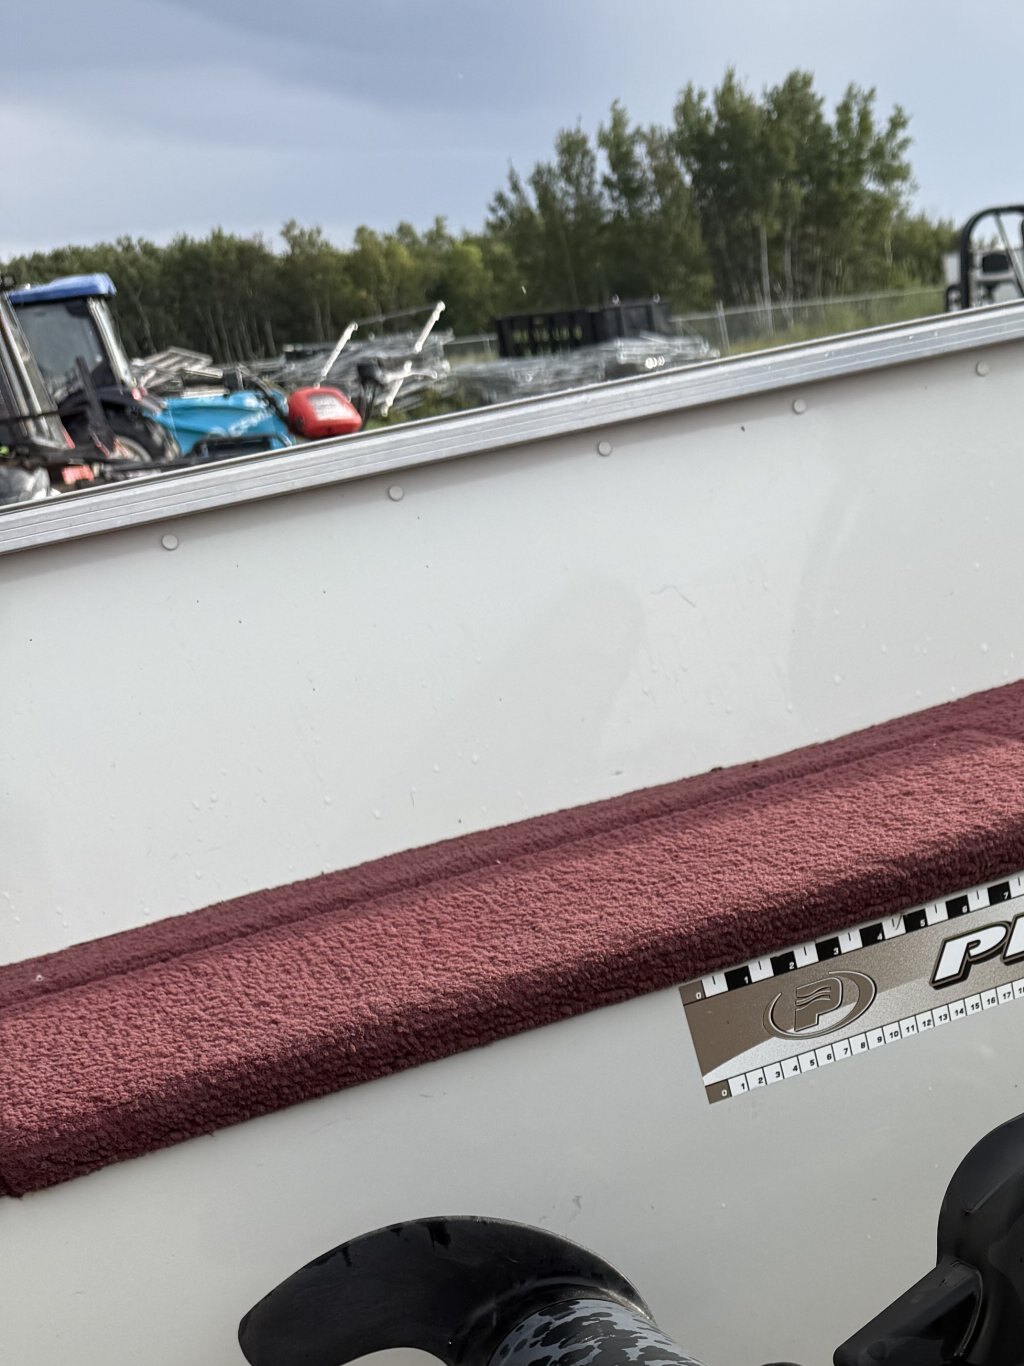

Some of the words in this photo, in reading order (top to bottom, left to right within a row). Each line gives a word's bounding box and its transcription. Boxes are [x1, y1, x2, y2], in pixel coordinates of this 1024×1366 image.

[695, 992, 702, 1000] 0
[744, 976, 749, 984] 1
[789, 961, 795, 970] 2
[833, 947, 839, 955] 3
[920, 919, 926, 927] 5
[962, 905, 968, 913] 6
[1003, 891, 1009, 899] 7
[721, 1089, 728, 1097] 0
[826, 1053, 832, 1061] 6
[843, 1047, 849, 1055] 7
[889, 1030, 899, 1039] 10
[906, 1024, 915, 1033] 11
[922, 1019, 932, 1027] 12
[938, 1013, 948, 1021] 13
[955, 1008, 964, 1016] 14
[971, 1002, 980, 1010] 15
[987, 997, 996, 1005] 16
[1003, 991, 1011, 1000] 17
